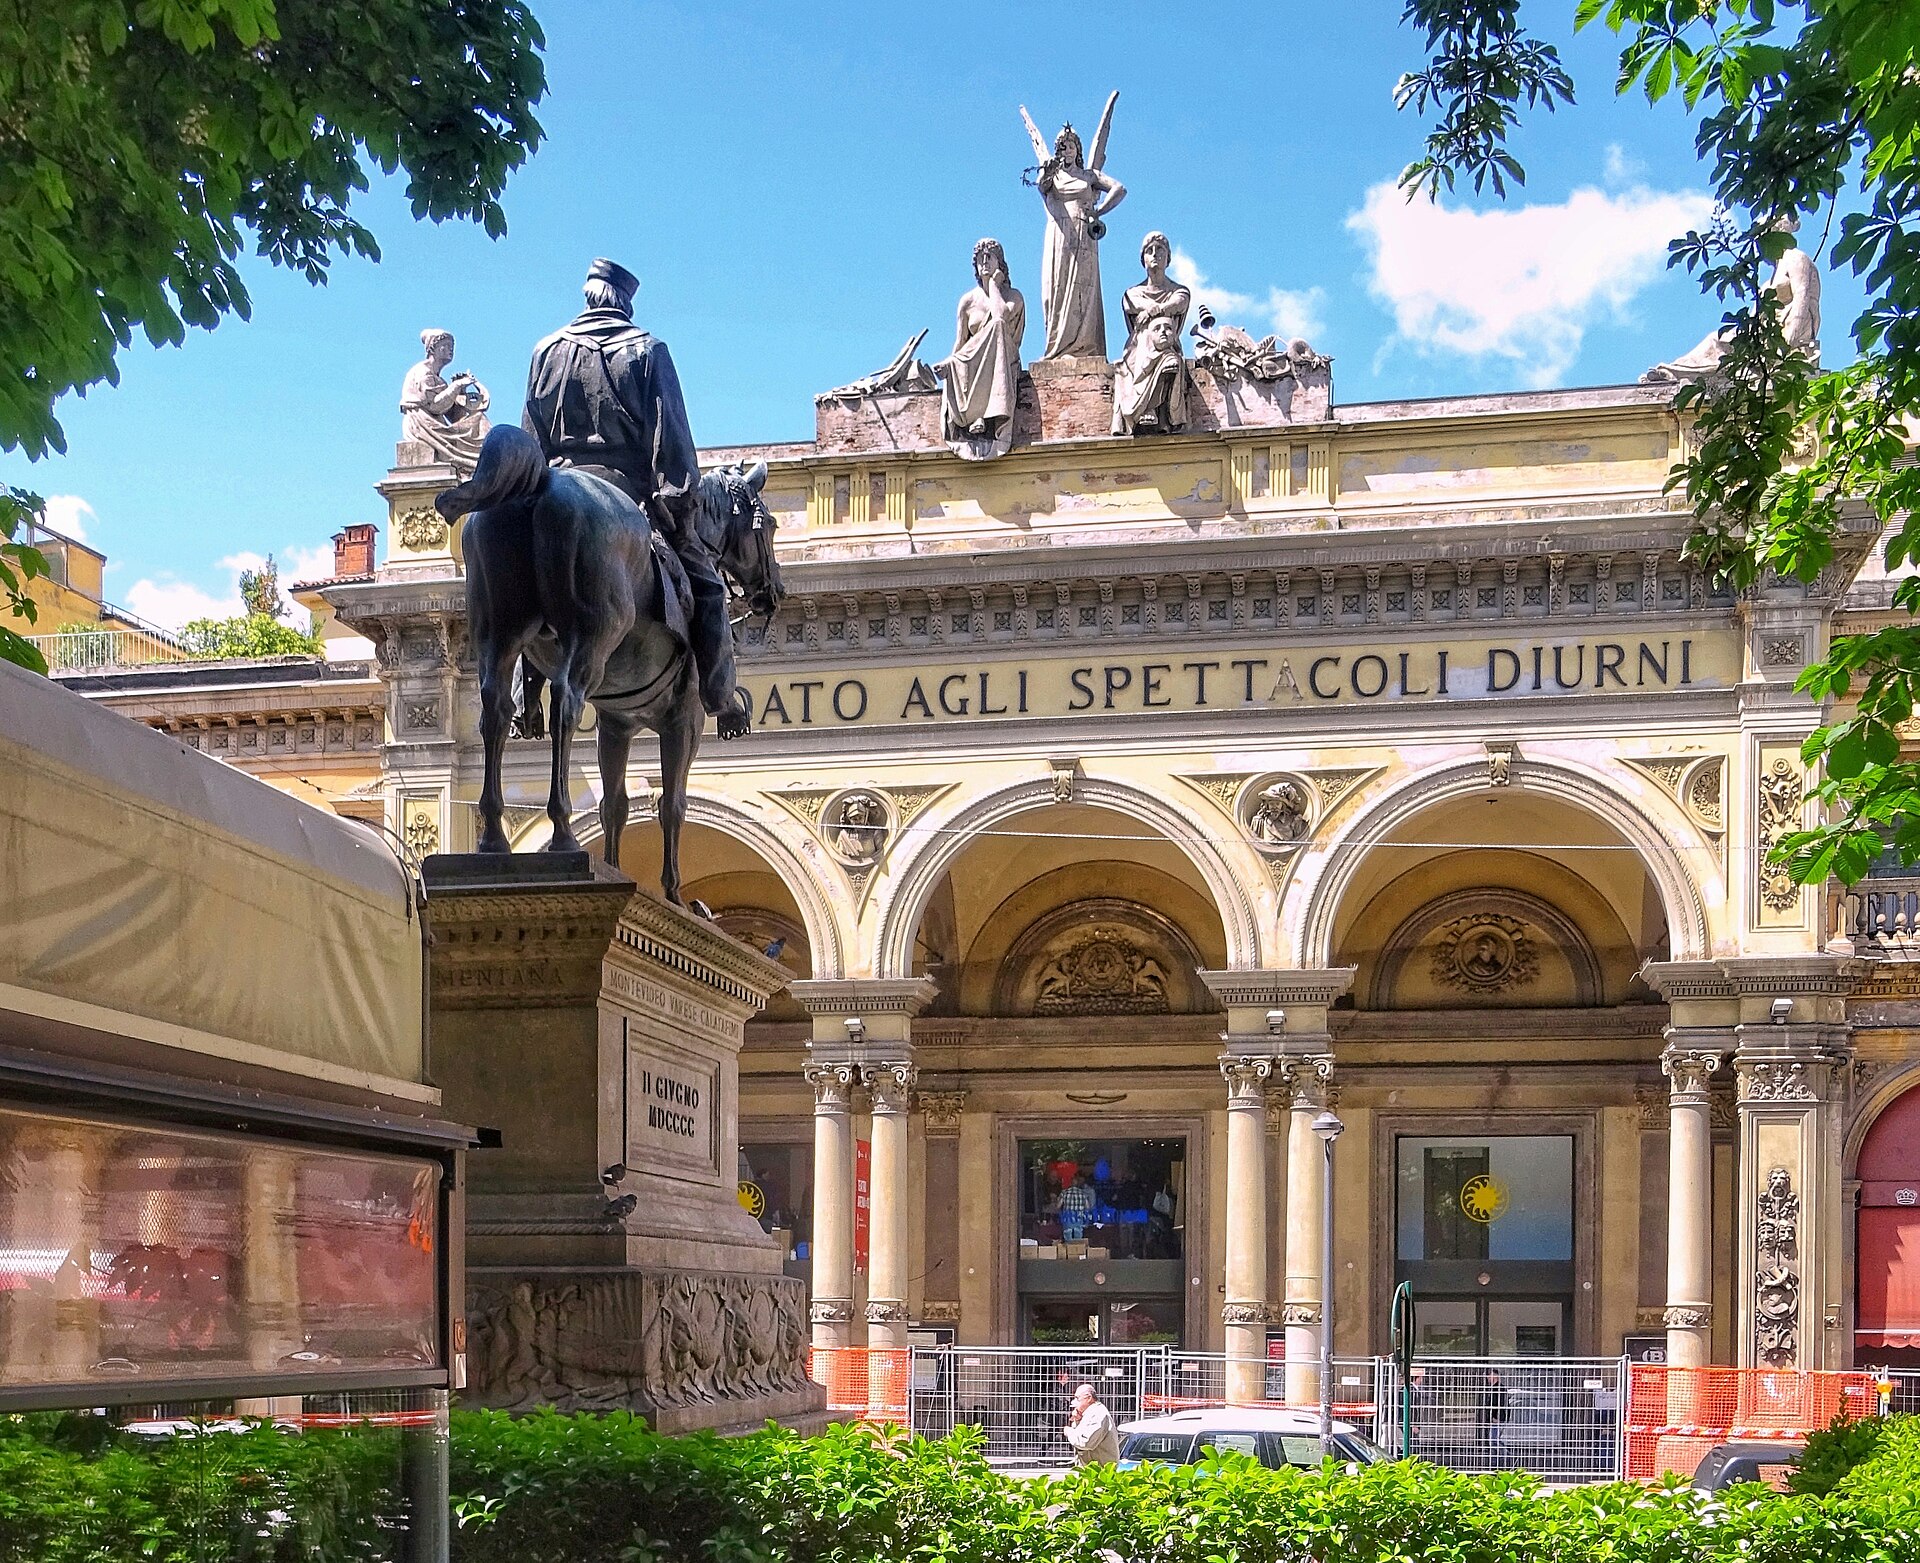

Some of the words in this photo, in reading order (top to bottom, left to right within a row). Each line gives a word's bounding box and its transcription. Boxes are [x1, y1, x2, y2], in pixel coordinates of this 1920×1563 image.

[900, 670, 1029, 718] AGLI
[1068, 650, 1449, 710] SPETTACOLI
[1486, 640, 1692, 692] DIURNI
[436, 965, 564, 987] MENTANA
[610, 969, 666, 1007] MONTEVIDEO
[656, 1076, 699, 1109] GIVGNO
[649, 1104, 694, 1138] MDCCCC
